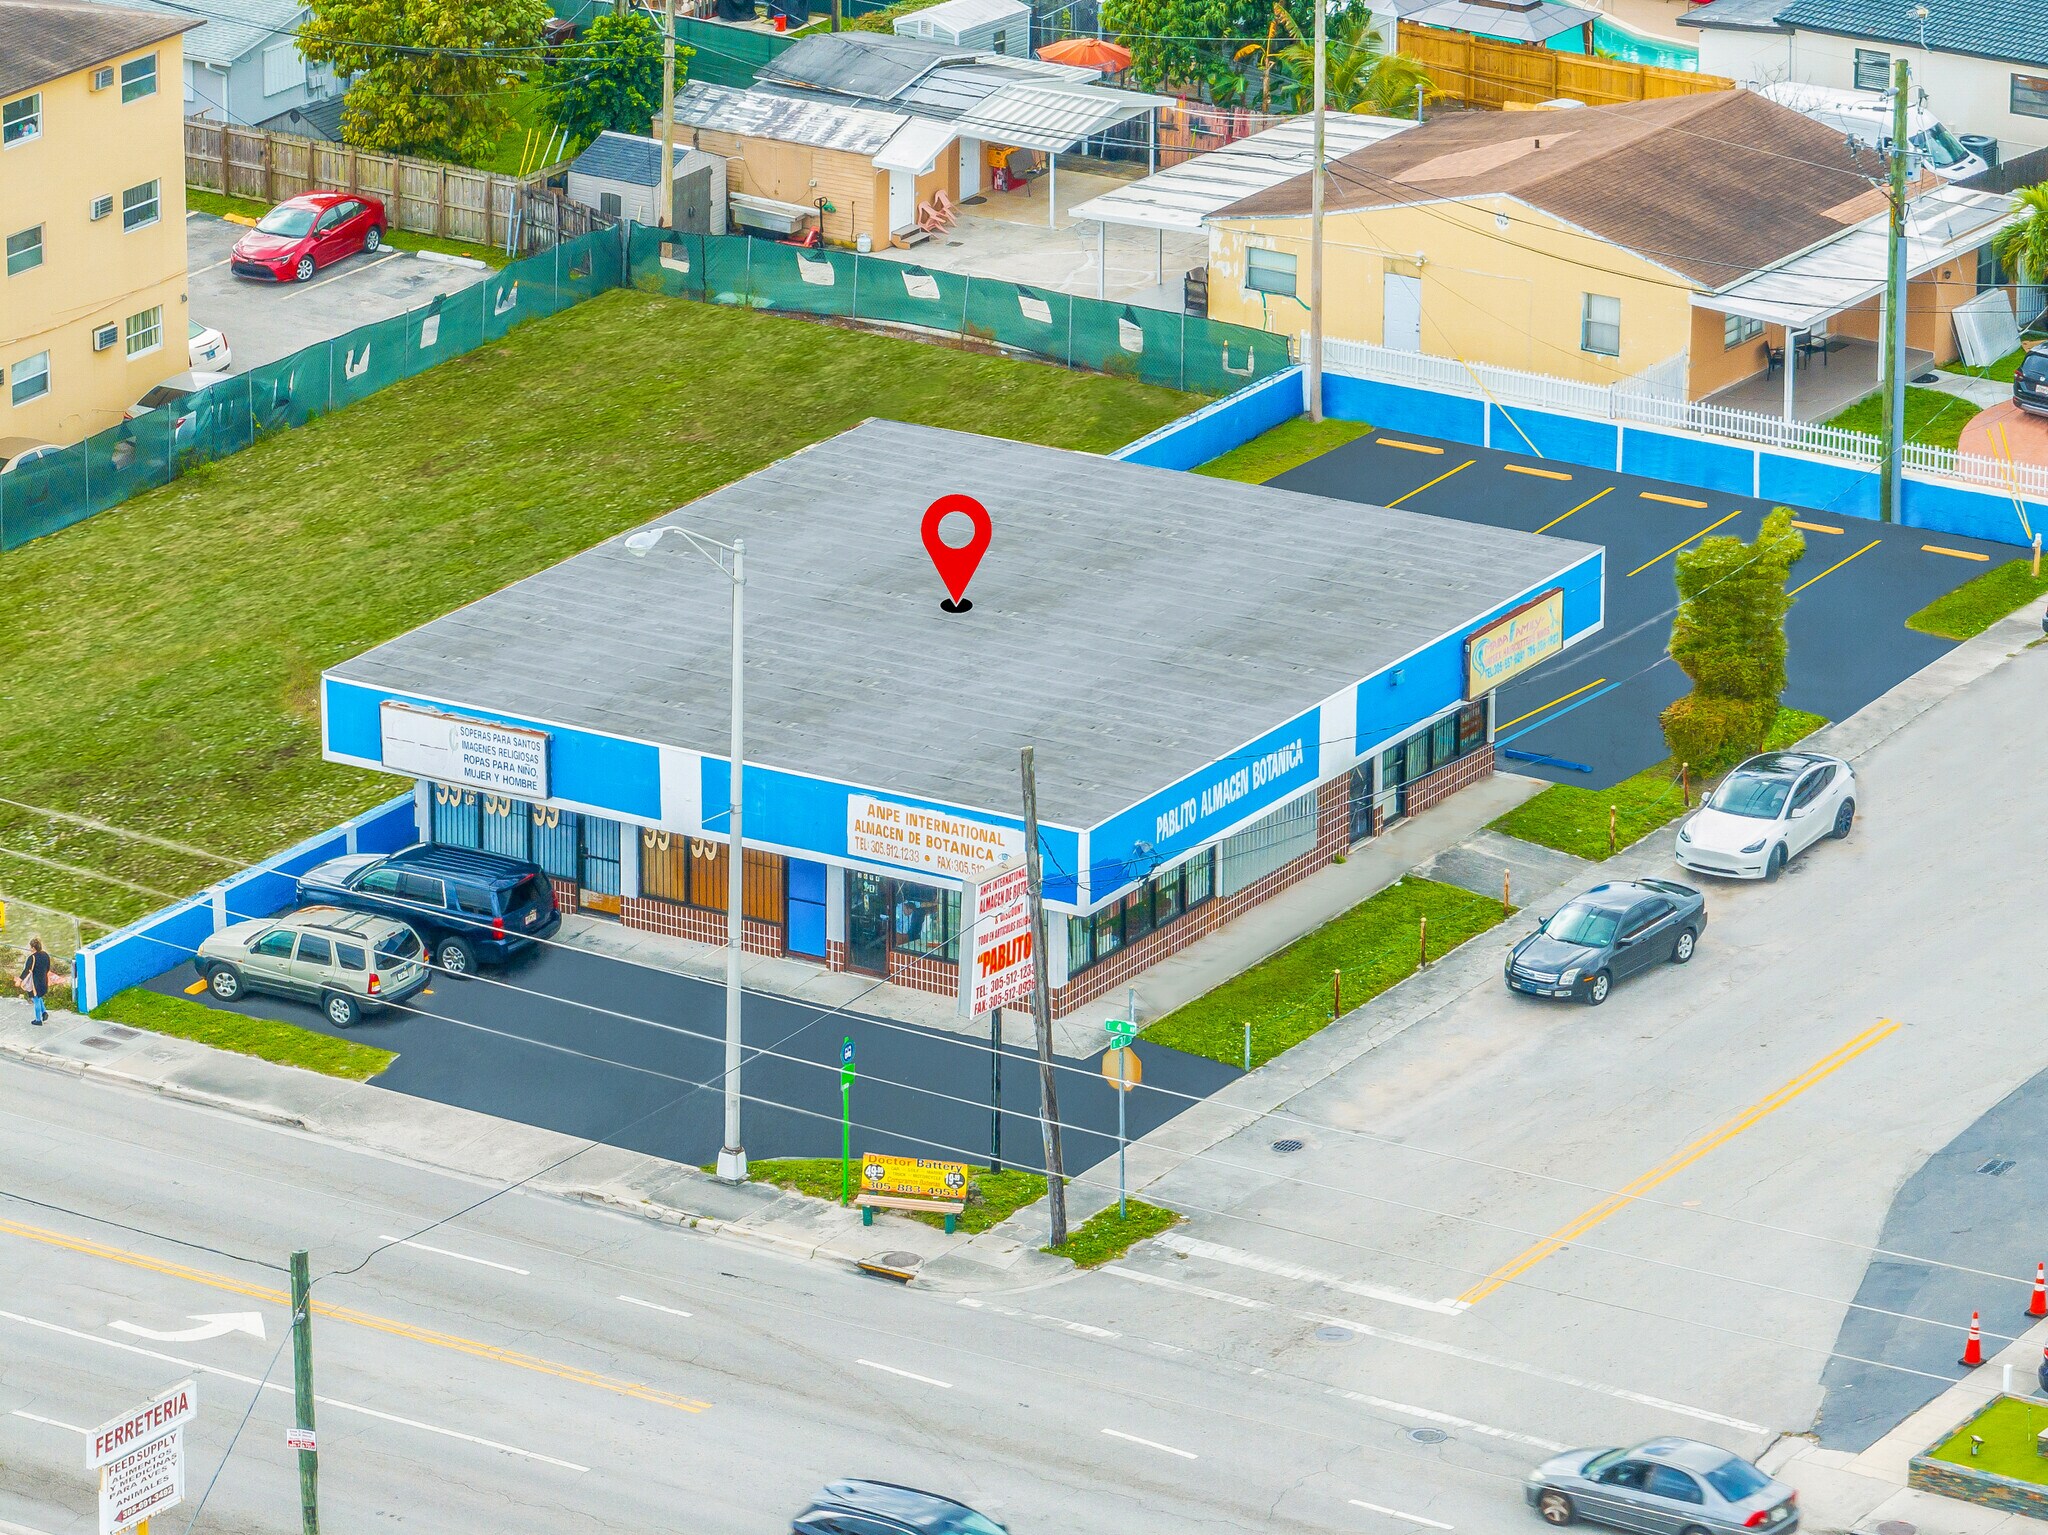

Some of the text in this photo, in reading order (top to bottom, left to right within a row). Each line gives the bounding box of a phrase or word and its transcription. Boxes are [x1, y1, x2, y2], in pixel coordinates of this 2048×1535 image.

[460, 726, 491, 742] SOPERAS
[493, 733, 511, 746] PARA
[513, 737, 541, 751] SANTOS
[461, 740, 497, 756] IMAGENES
[498, 747, 539, 764] RELIGIOSAS
[463, 753, 491, 768] ROPAS
[492, 760, 515, 772] PARA
[464, 767, 538, 791] MUJER Y HOMBRE
[1156, 738, 1304, 844] PABLITO ALMACEN BOTANICA
[867, 803, 1005, 847] ANPE INTERNATIONAL
[854, 819, 994, 862] ALMACEN DE BOTANICA
[979, 890, 1005, 914] ALMACEN
[1005, 887, 1013, 903] DE
[980, 883, 992, 897] ANPE
[978, 933, 989, 947] TODO
[989, 931, 995, 941] EN
[976, 984, 988, 999] TEL:
[974, 1001, 987, 1015] FAX:
[1117, 1023, 1121, 1032] 4
[868, 1154, 962, 1173] Doctor Battery
[868, 1181, 959, 1197] 305-883-4953
[95, 1391, 189, 1459] FERRETERIA
[108, 1433, 177, 1477] FEED SUPPLY
[112, 1448, 172, 1485] ALIMENTOS
[109, 1459, 178, 1500] PARA AVES Y
[110, 1453, 177, 1492] Y MEDICINAS
[116, 1475, 170, 1508] ANIMALES
